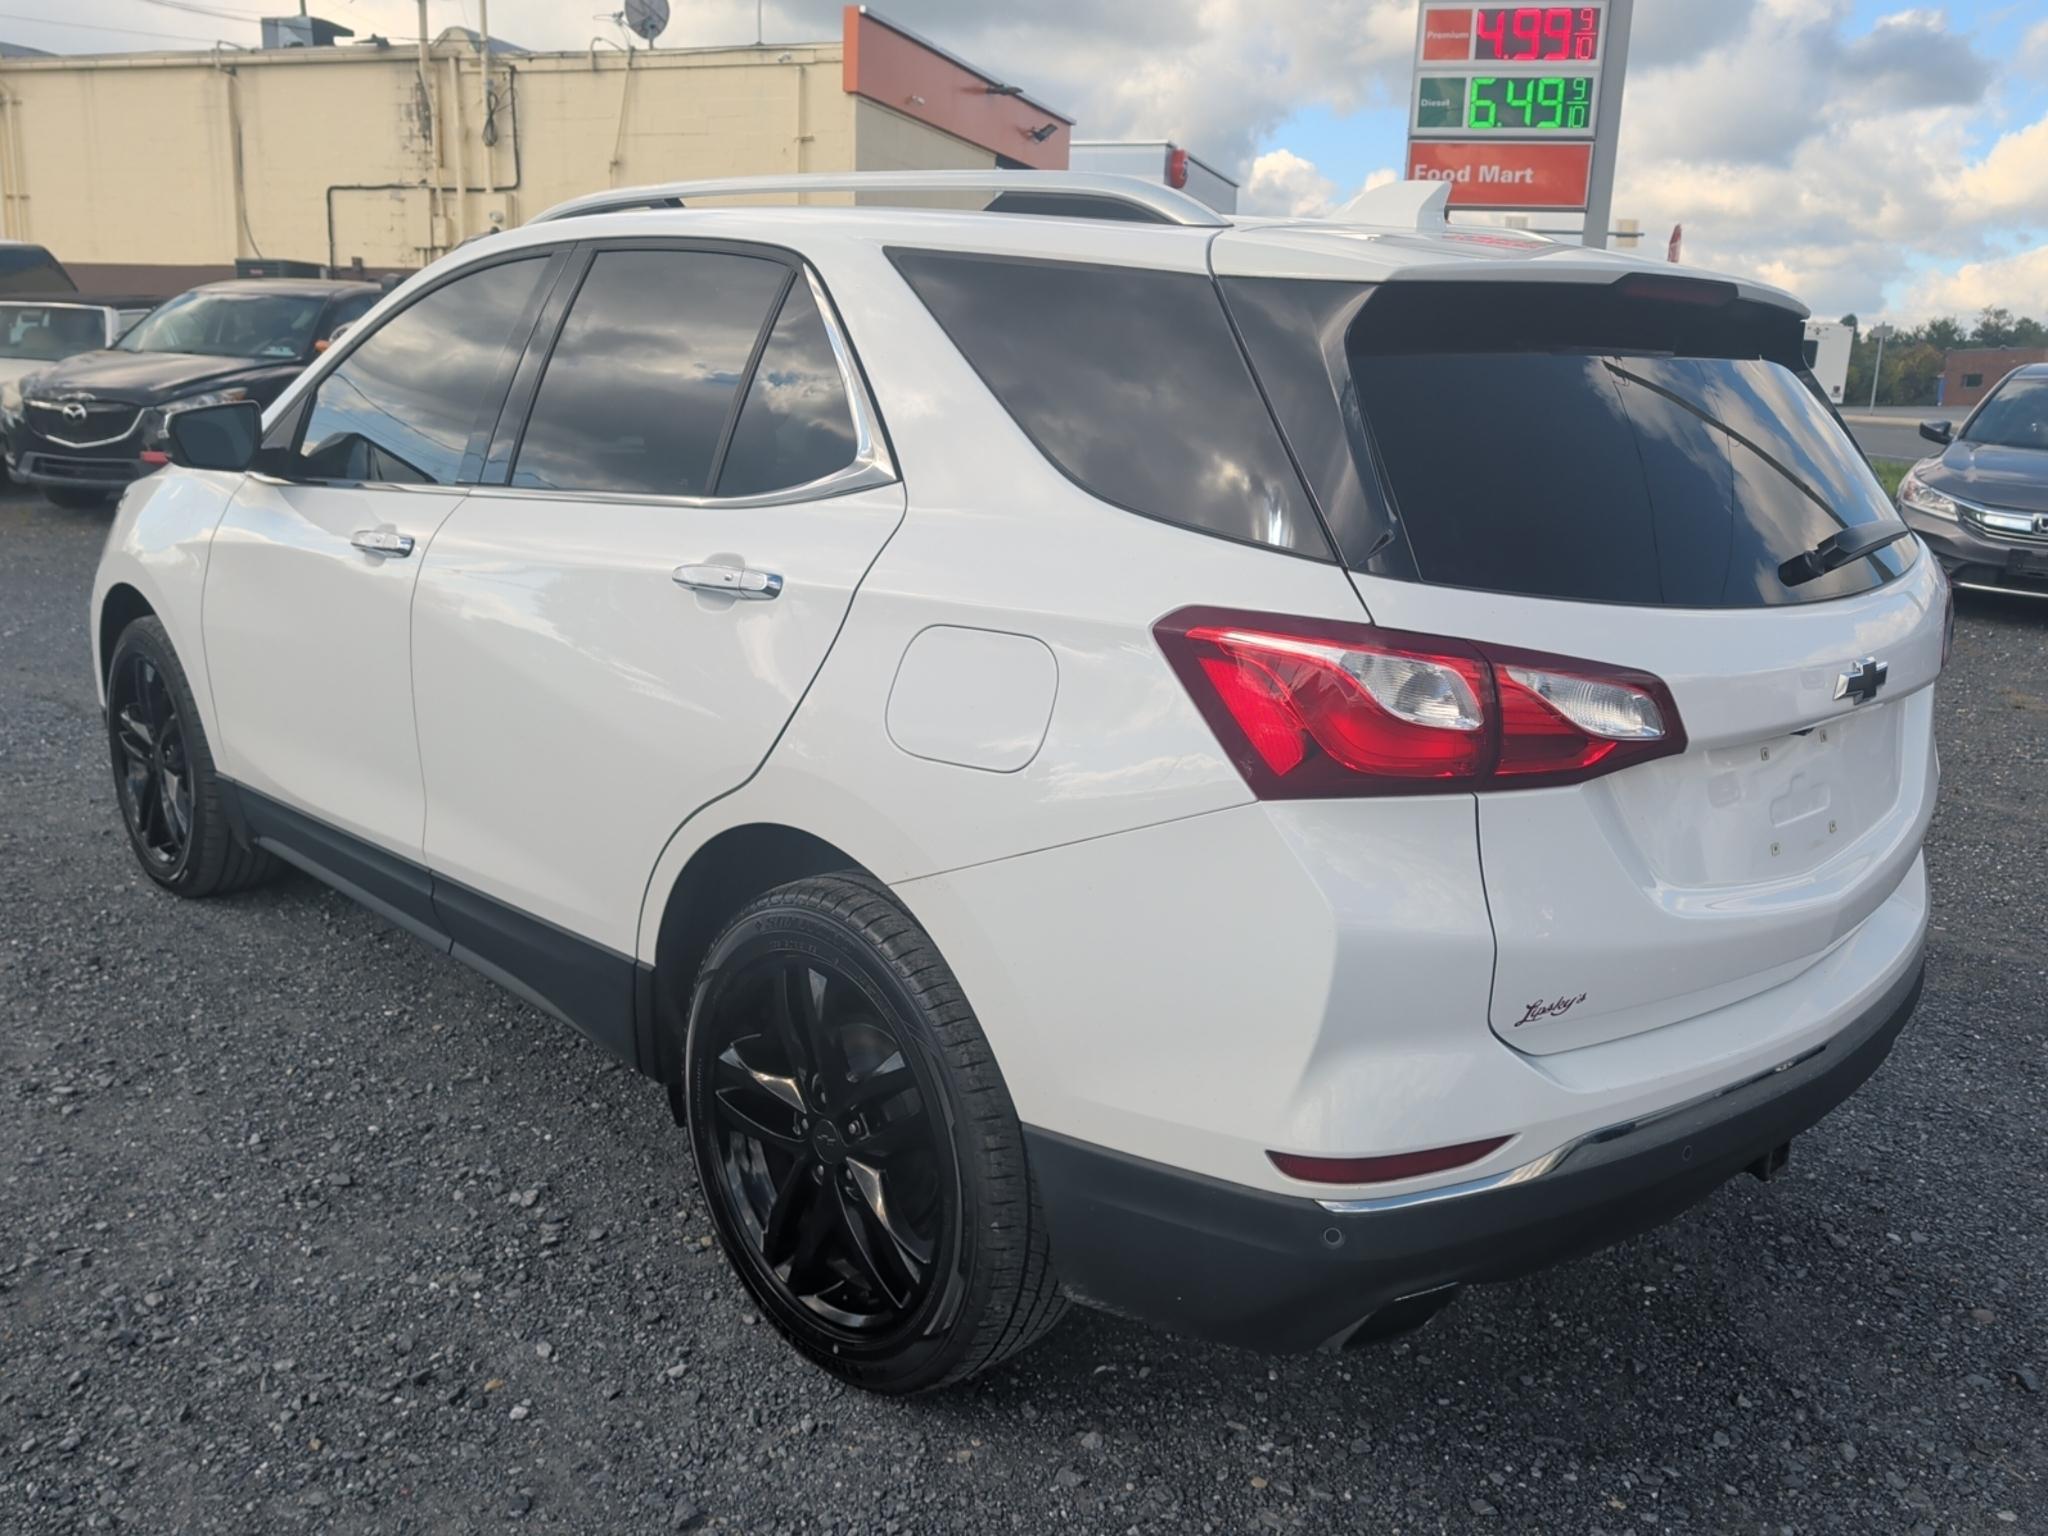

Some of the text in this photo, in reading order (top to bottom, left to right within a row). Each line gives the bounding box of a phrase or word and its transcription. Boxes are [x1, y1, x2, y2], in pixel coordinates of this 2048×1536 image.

[1427, 8, 1573, 61] Premium 4.99
[1421, 77, 1565, 128] Diesel 6.49
[1414, 164, 1534, 183] Food Mart
